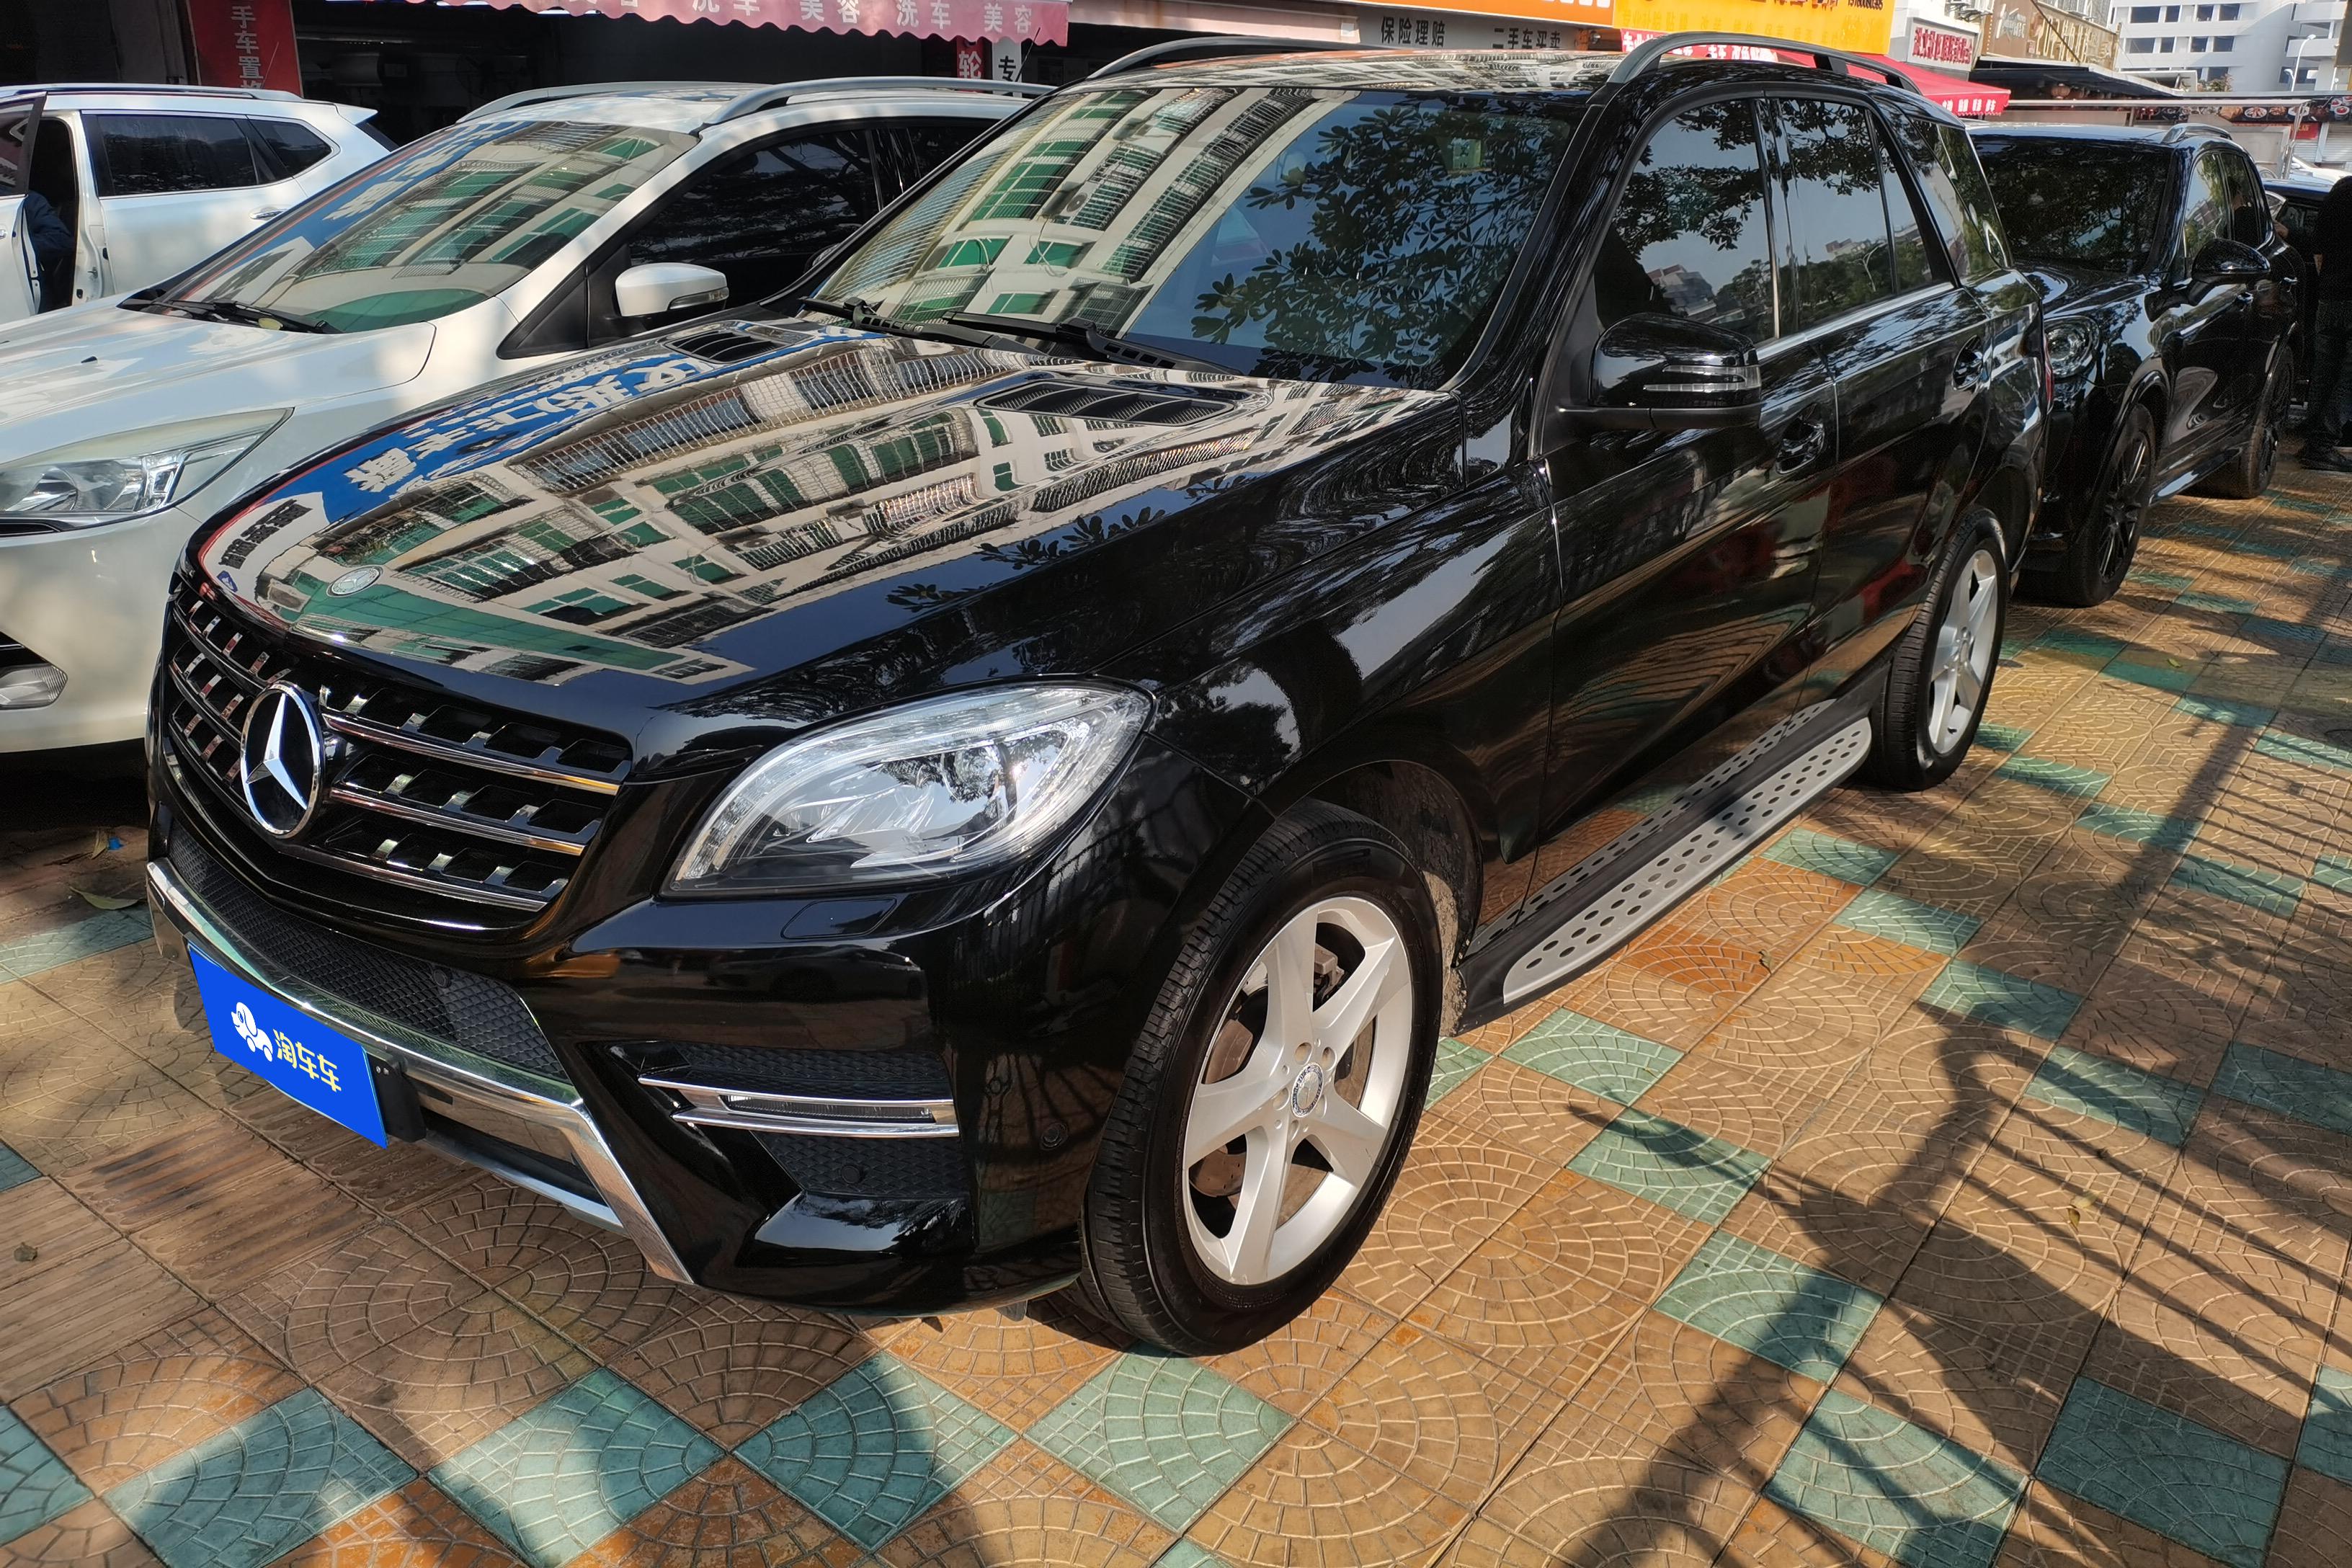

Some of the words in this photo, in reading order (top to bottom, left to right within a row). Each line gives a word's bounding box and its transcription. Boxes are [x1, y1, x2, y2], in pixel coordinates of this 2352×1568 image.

[896, 2, 952, 30] 洗车
[984, 4, 1032, 33] 美容
[1381, 16, 1446, 47] 保险理赔
[1492, 27, 1561, 49] 二手车买卖
